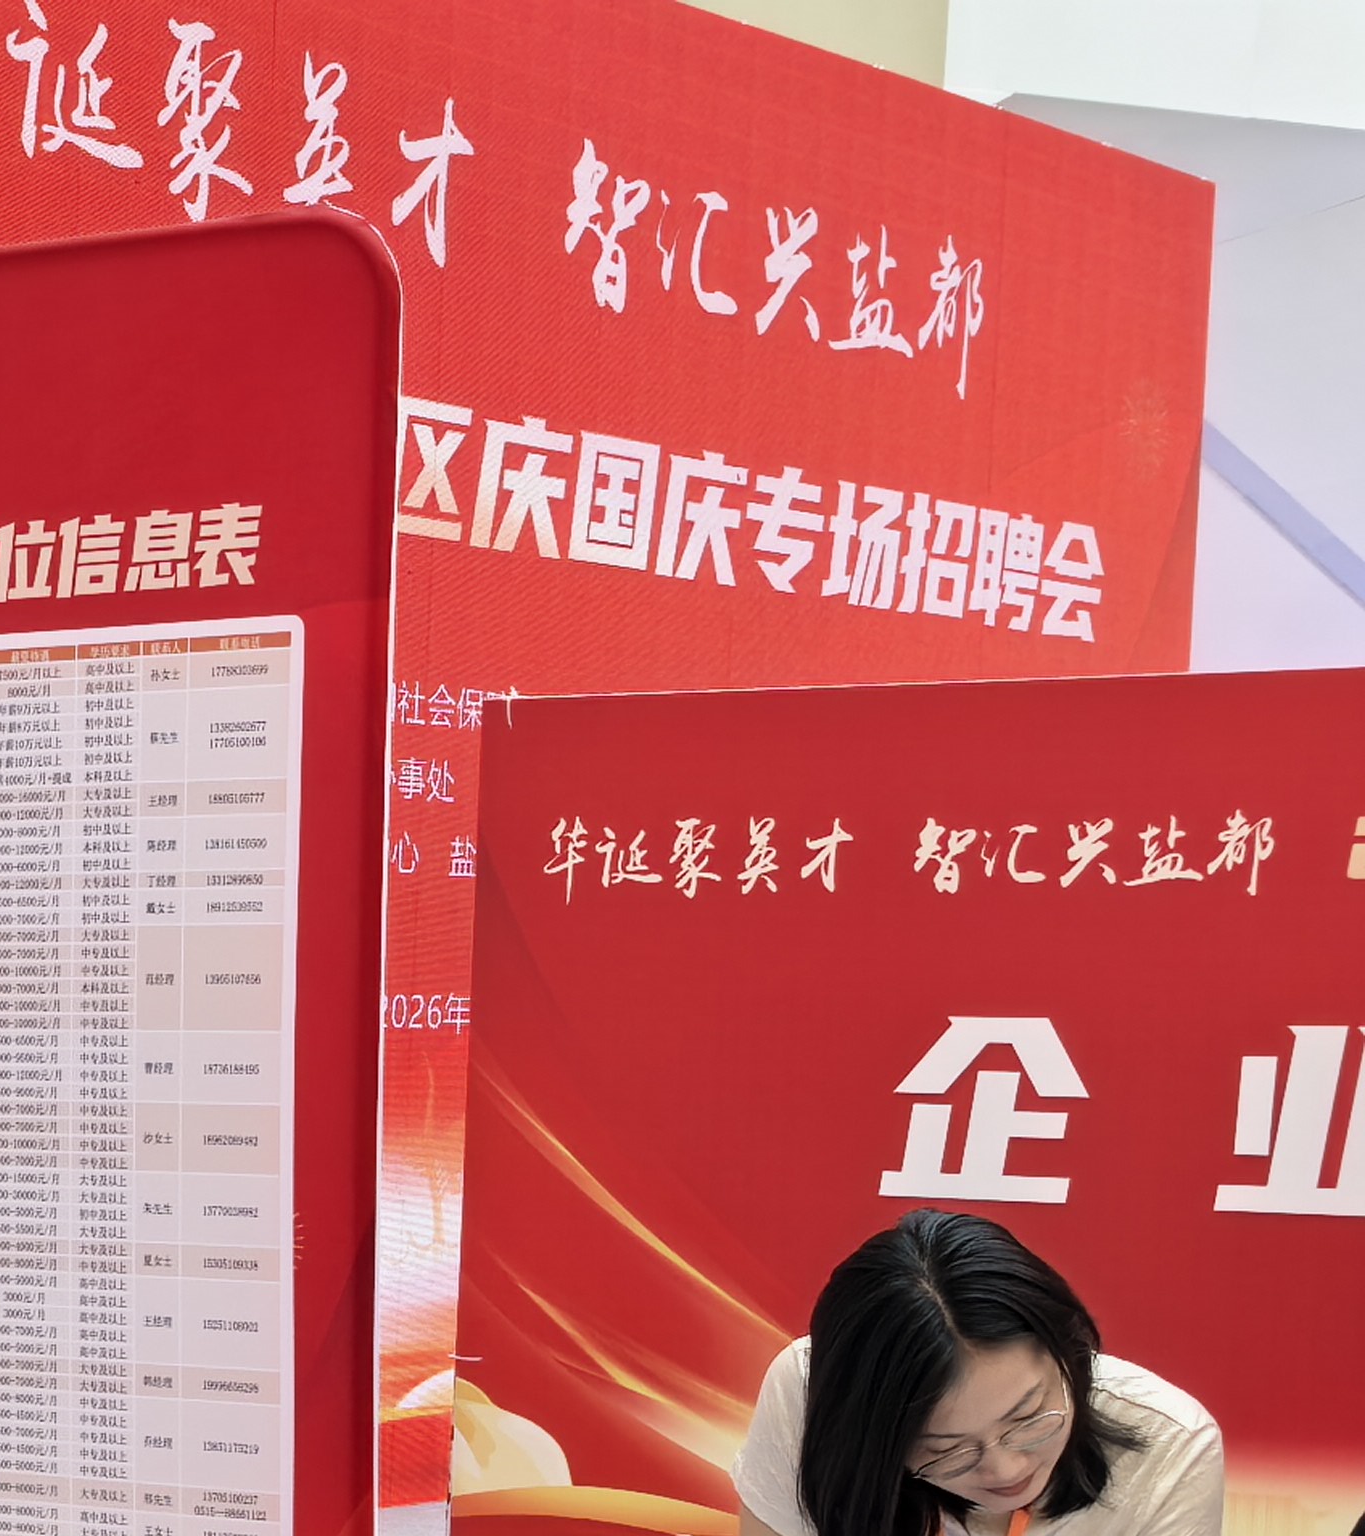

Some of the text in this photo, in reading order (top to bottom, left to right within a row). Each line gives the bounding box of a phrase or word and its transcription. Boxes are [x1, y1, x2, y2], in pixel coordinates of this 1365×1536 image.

[563, 137, 984, 400] 智汇兴盐都
[397, 396, 1105, 642] 区庆国庆专场招聘会
[392, 682, 483, 730] 社会保
[389, 757, 455, 802] 事处
[543, 816, 854, 902] 华诞聚英才
[913, 809, 1275, 896] 智汇兴盐都
